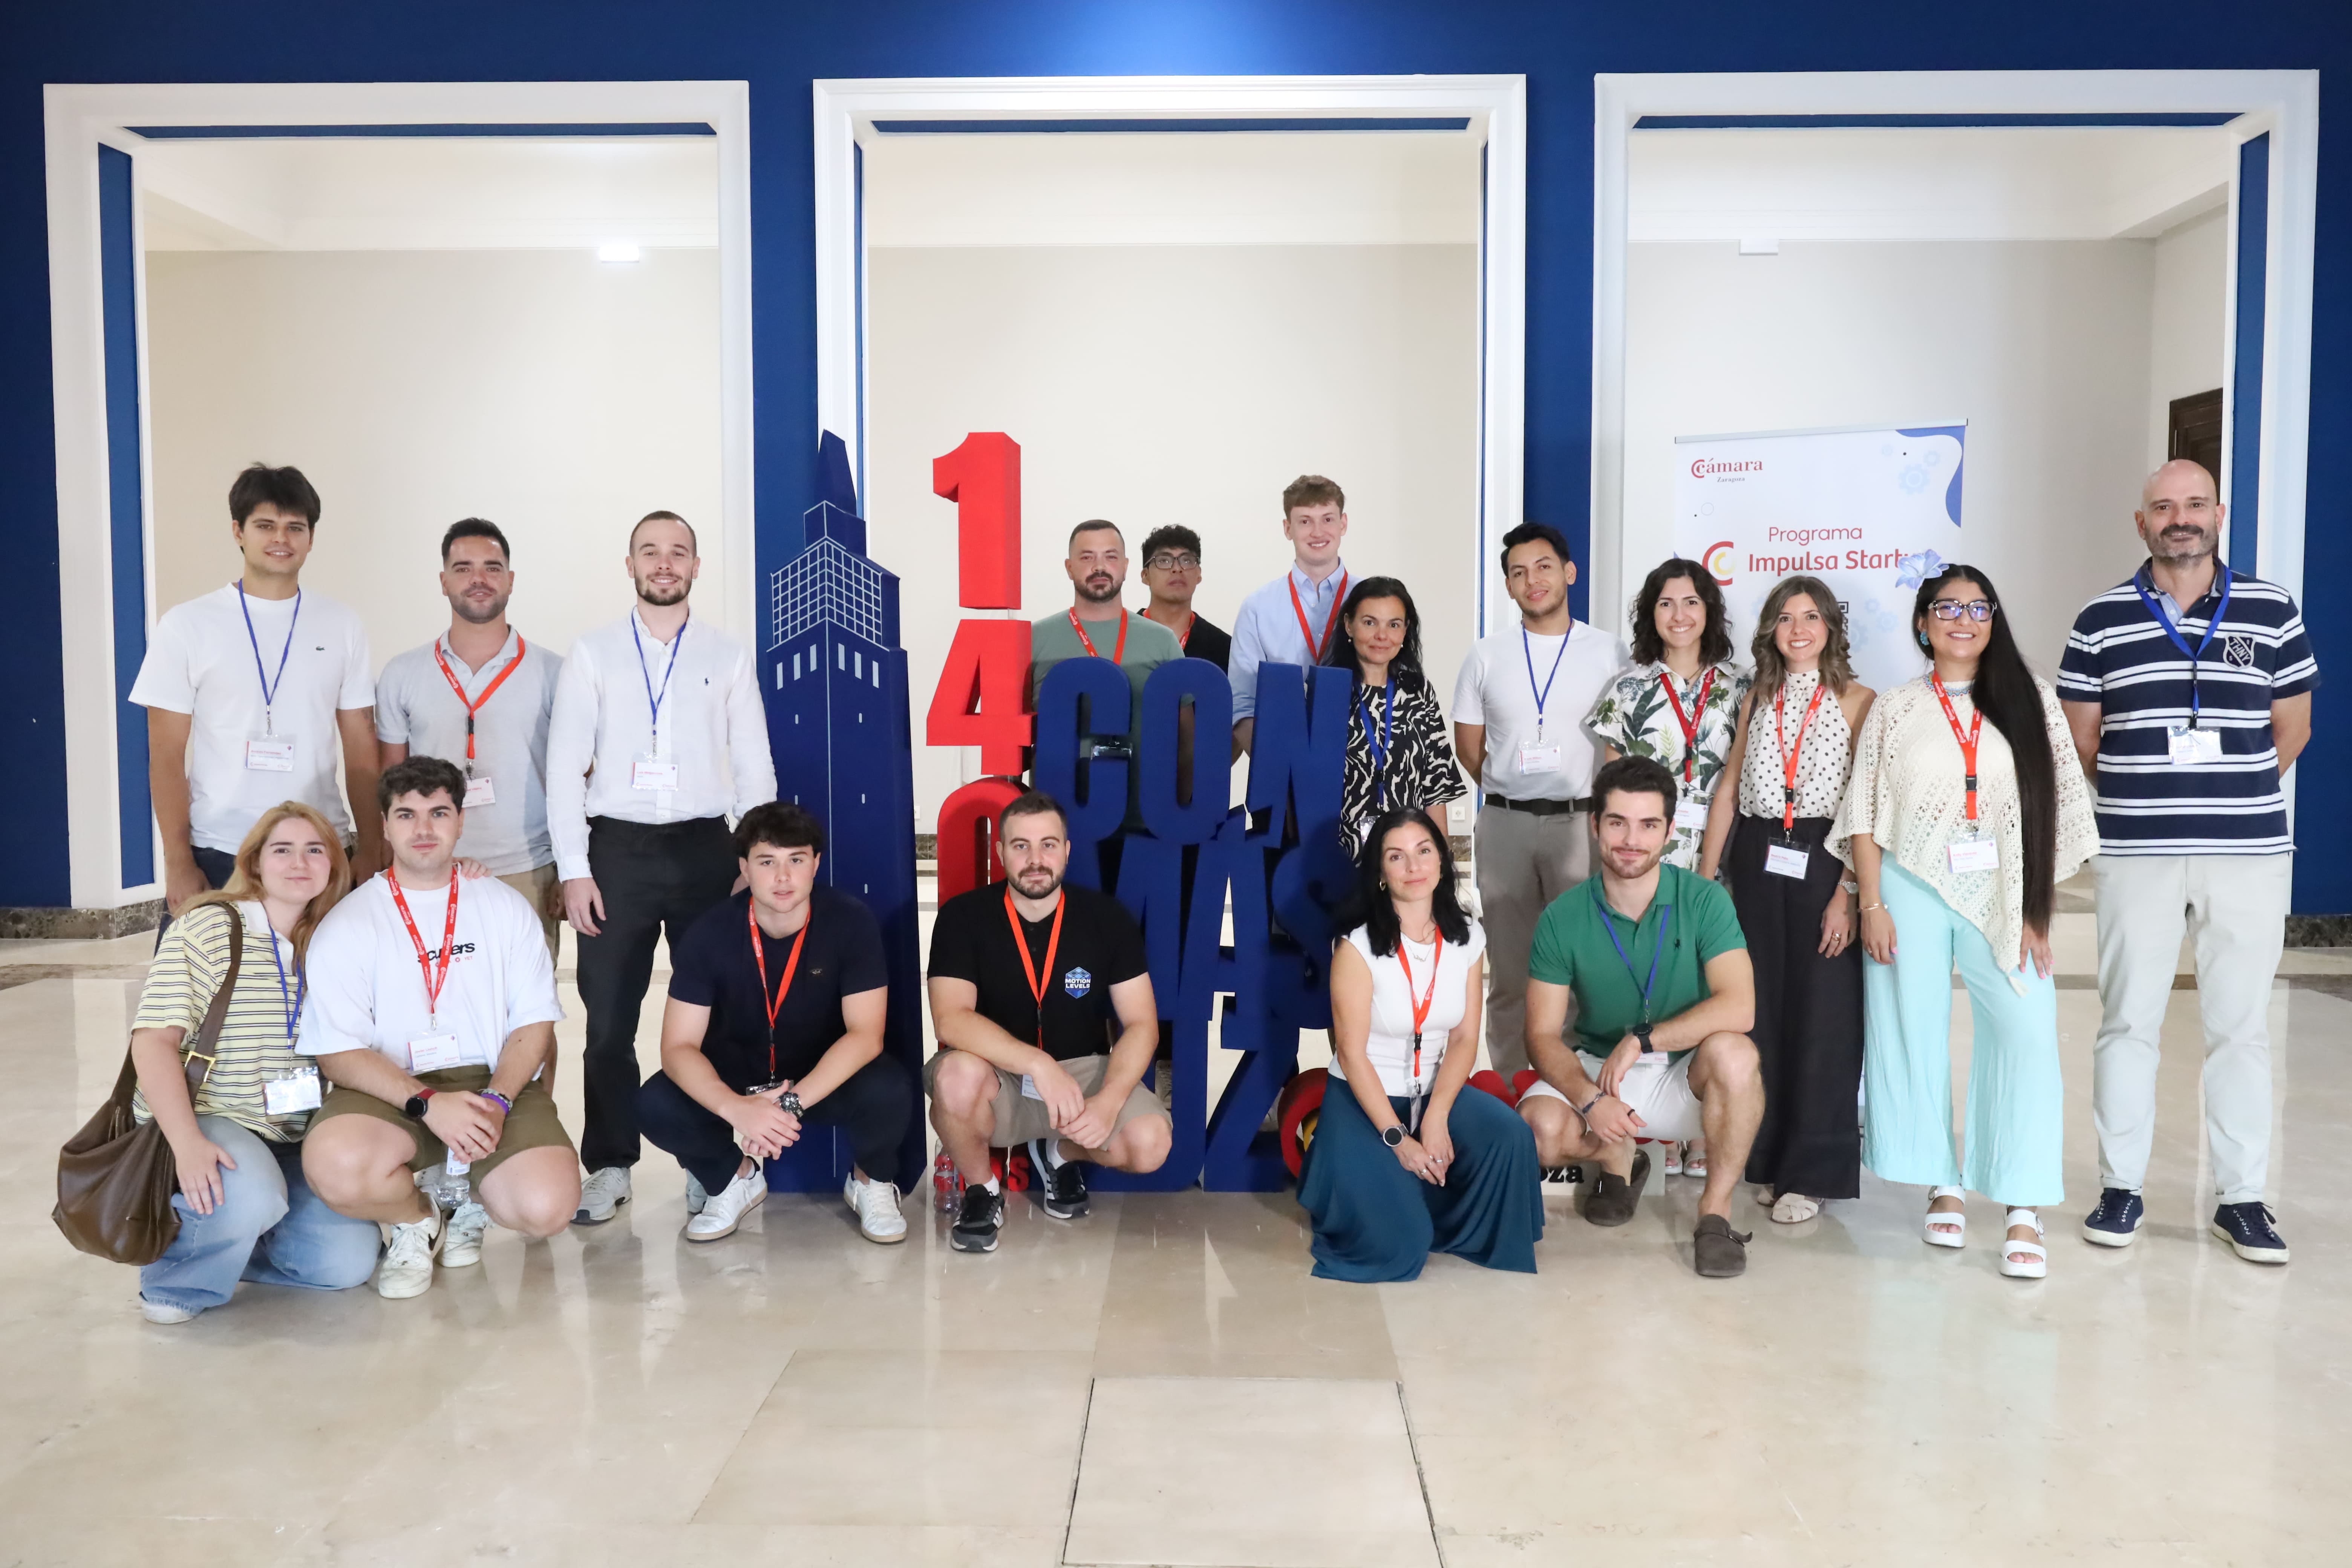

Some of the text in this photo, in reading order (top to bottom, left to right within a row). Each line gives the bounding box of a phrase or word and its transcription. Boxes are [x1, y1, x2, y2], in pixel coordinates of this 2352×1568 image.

[1769, 527, 1862, 546] Programa
[1749, 551, 1838, 576] Impulsa
[2230, 637, 2251, 662] THNY
[1035, 657, 1352, 848] CON
